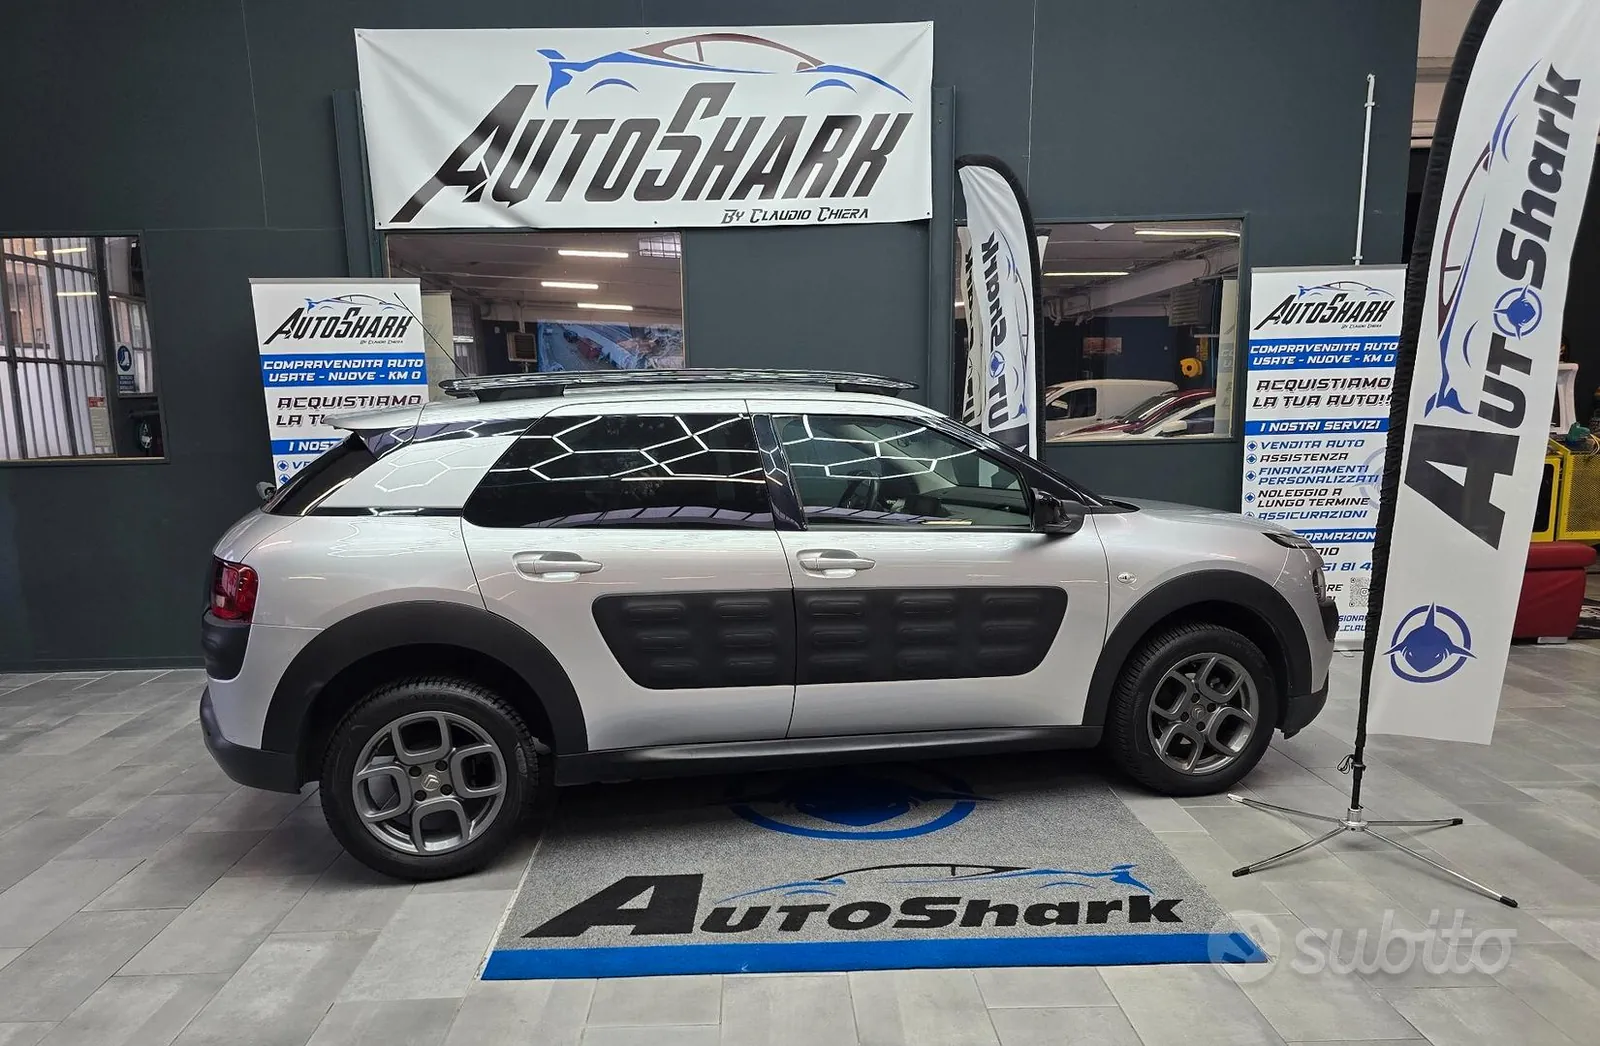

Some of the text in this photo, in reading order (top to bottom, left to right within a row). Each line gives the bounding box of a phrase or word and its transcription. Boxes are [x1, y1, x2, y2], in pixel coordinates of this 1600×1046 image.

[391, 82, 912, 223] AUTOSHARK
[720, 206, 869, 224] BY CLAUDIO CHIERA
[1250, 342, 1399, 354] COMPRAVENDITA AUTO
[263, 358, 424, 370] COMPRAVENDITA AUTO
[1253, 356, 1296, 365] USATE
[1307, 355, 1352, 364] NUOVE
[1363, 354, 1381, 363] KM
[269, 372, 315, 382] USATE
[328, 371, 376, 381] NUOVE
[388, 371, 407, 380] KM
[1256, 377, 1391, 393] ACQUISTIAMO
[277, 395, 422, 409] ACQUISTIAMO
[1252, 394, 1392, 408] LA TUA AUTO!!
[276, 414, 302, 426] LA
[1260, 419, 1381, 432] I NOSTRI SERVIZI
[288, 440, 335, 451] I NOS
[1260, 439, 1365, 450] VENDITA AUTO
[1260, 453, 1349, 462] ASSISTENZA
[1259, 465, 1369, 475] FINANZIAMENTI
[1258, 474, 1379, 485] PERSONALIZZATI
[1257, 488, 1342, 498] NOLEGGIO A
[1257, 497, 1370, 508] LUNGO TERMINE
[1258, 510, 1368, 520] ASSICURAZIONI
[1300, 531, 1376, 541] ORMAZION
[1326, 584, 1343, 592] RE
